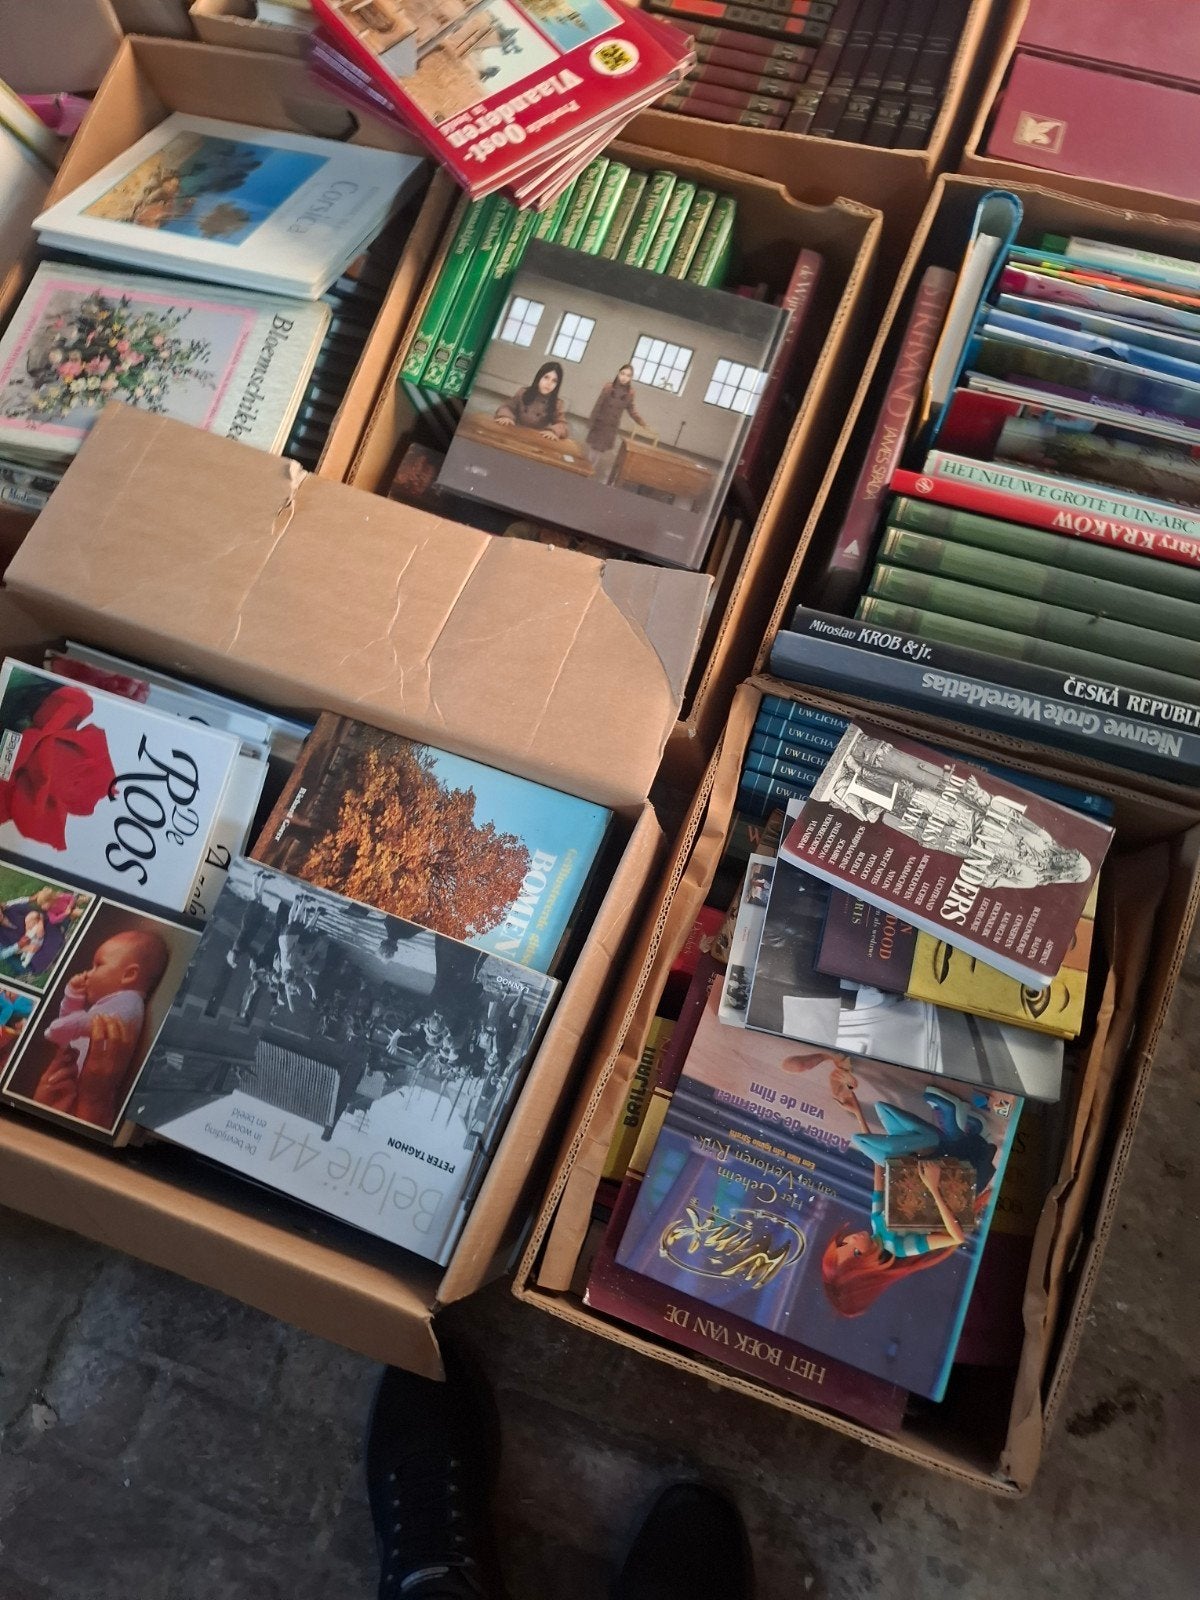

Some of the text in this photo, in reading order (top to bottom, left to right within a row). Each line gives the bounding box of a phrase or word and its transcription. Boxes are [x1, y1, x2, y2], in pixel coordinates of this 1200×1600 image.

[446, 69, 584, 148] Vlaanderen
[463, 123, 527, 162] Oost-
[861, 424, 898, 501] JAMES SPADA
[942, 460, 1196, 535] HET NIEUWE GROTE TUIN-ABC
[1052, 511, 1155, 551] KRAKÓW
[808, 619, 856, 640] Miroslav
[858, 628, 901, 652] KROB
[1062, 676, 1119, 707] ČESKÁ
[798, 708, 815, 718] UW
[921, 671, 1183, 758] Nieuwe Grote Wereldatlas
[785, 747, 800, 757] UW
[789, 728, 837, 749] UW LICHA
[780, 766, 796, 775] UW
[104, 733, 200, 886] Roos
[776, 786, 791, 797] UW
[921, 774, 967, 845] DAGELIJKS
[165, 805, 200, 847] De
[898, 790, 930, 835] LEVEN
[797, 820, 818, 850] VUILNISBAK
[807, 813, 835, 855] VIDEORECORDER
[817, 821, 843, 861] SNELKOOKPAN
[828, 838, 846, 866] SCRABBLE
[838, 825, 866, 871] SCHRIJFMACHINE
[849, 851, 866, 876] ROLFILM
[860, 854, 878, 881] POTLOOD
[871, 847, 894, 886] POST-IT NOTES
[903, 853, 931, 901] MICROGOLFOVEN
[939, 795, 1028, 927] UITVINDERS
[881, 869, 897, 891] NYLON
[914, 881, 930, 906] LUCIFER
[925, 876, 947, 911] LUCHTBAND
[494, 848, 558, 959] BOMEN
[993, 911, 1012, 944] KAUWGUM
[1004, 914, 1024, 950] CONSERVEN
[497, 975, 530, 994] LANNOO
[231, 1107, 267, 1128] en beeld
[750, 1082, 825, 1120] van de film
[204, 1122, 257, 1155] De bevrijding
[226, 1120, 262, 1143] in woord
[717, 1089, 851, 1153] Achter de schermen
[387, 1136, 456, 1174] PETER TAGHON
[699, 1136, 731, 1162] Rijk
[772, 1148, 786, 1158] van
[787, 1152, 801, 1166] film
[802, 1158, 816, 1172] Een
[267, 1121, 444, 1235] België 44
[717, 1166, 777, 1204] Geheim
[735, 1150, 795, 1189] Verloren
[816, 1181, 838, 1198] van
[664, 1303, 826, 1385] HET BOEK VAN DE
